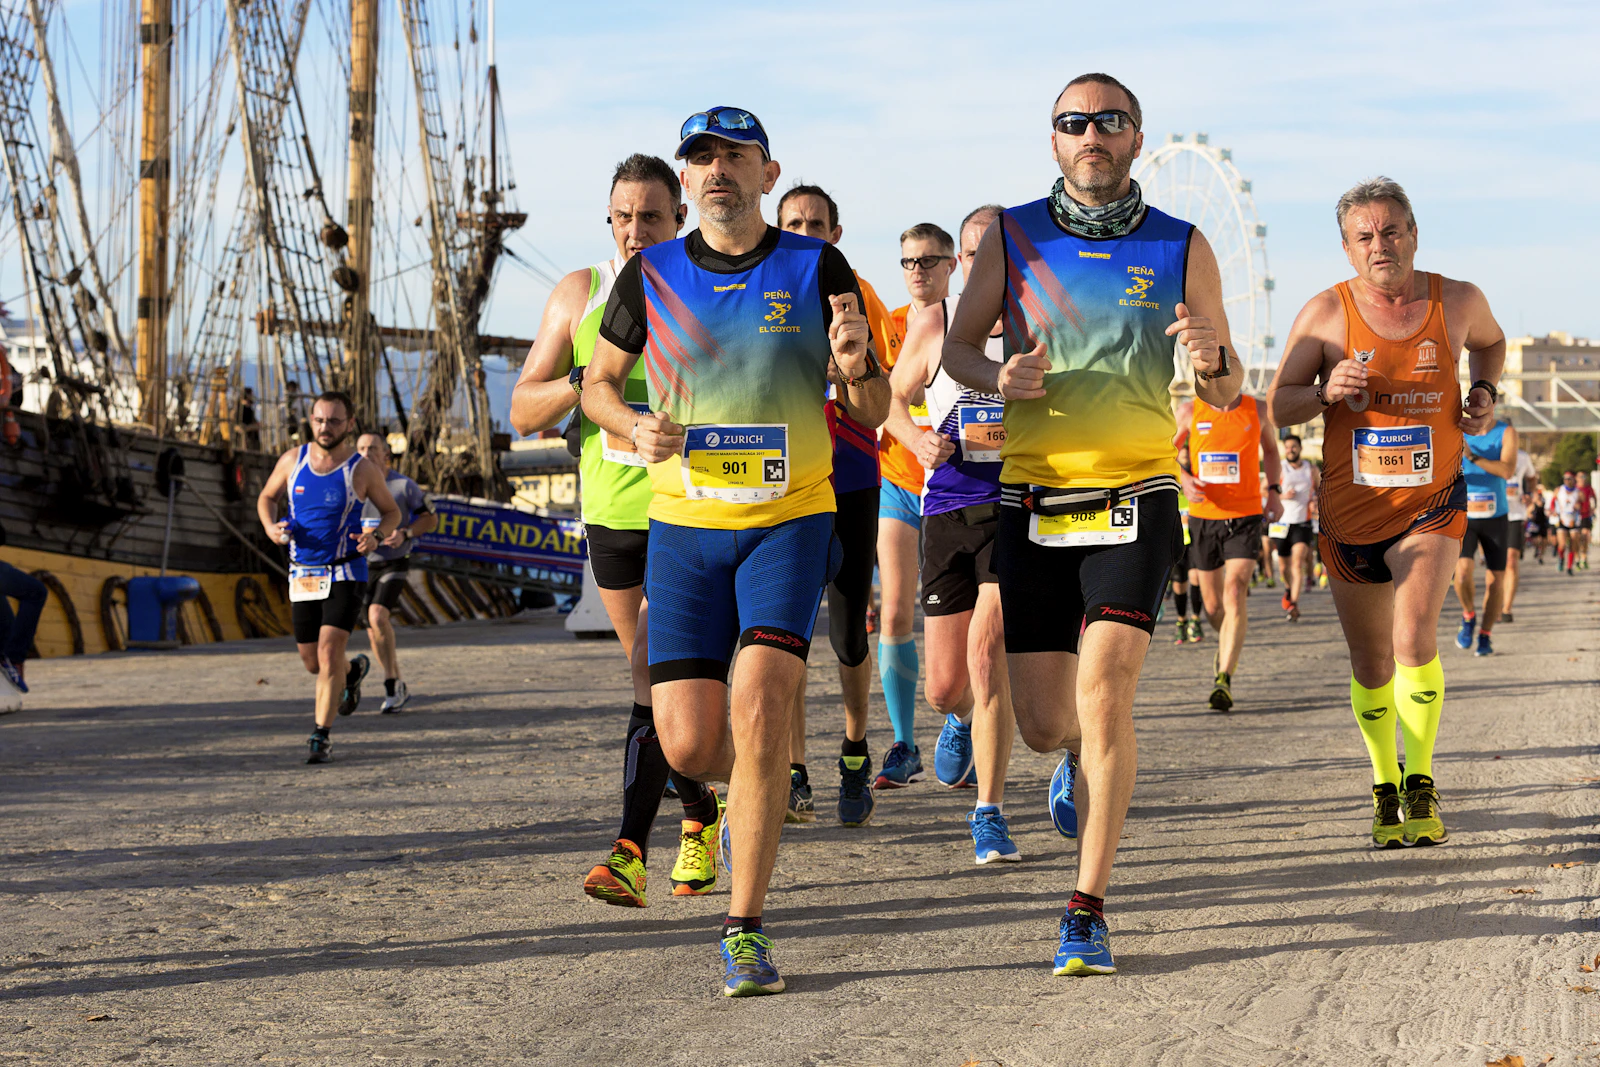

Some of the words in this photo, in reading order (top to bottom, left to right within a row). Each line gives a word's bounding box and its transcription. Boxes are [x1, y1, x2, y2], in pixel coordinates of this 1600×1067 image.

[1127, 265, 1155, 276] PEÑA
[763, 289, 792, 300] PEÑA
[1129, 299, 1160, 310] COYOTE
[770, 325, 801, 333] COYOTE
[989, 411, 1004, 419] ZU
[723, 434, 764, 444] ZURICH
[1380, 434, 1412, 443] ZURICH
[1378, 455, 1404, 466] 1861
[722, 461, 747, 475] 901
[1071, 511, 1097, 523] 908
[426, 511, 588, 556] HTANDAR
